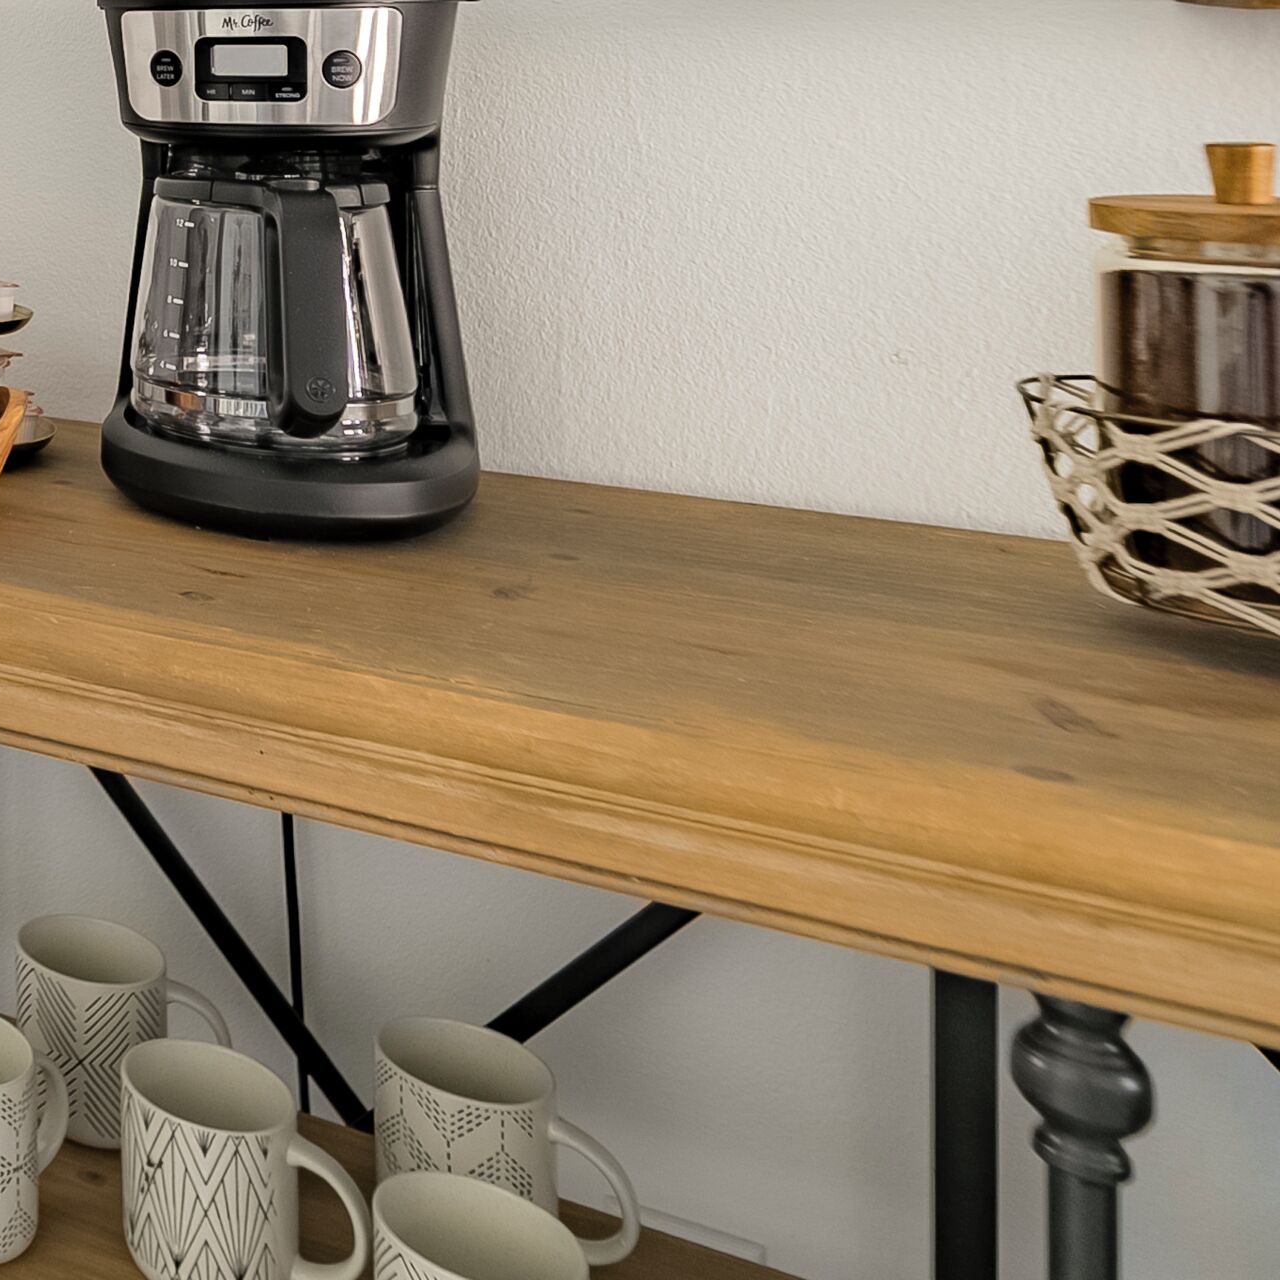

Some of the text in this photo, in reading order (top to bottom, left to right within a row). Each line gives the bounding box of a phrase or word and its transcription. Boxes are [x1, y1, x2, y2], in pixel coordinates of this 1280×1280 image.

[241, 14, 274, 32] Coffee
[176, 219, 184, 227] 12
[169, 258, 177, 267] 10
